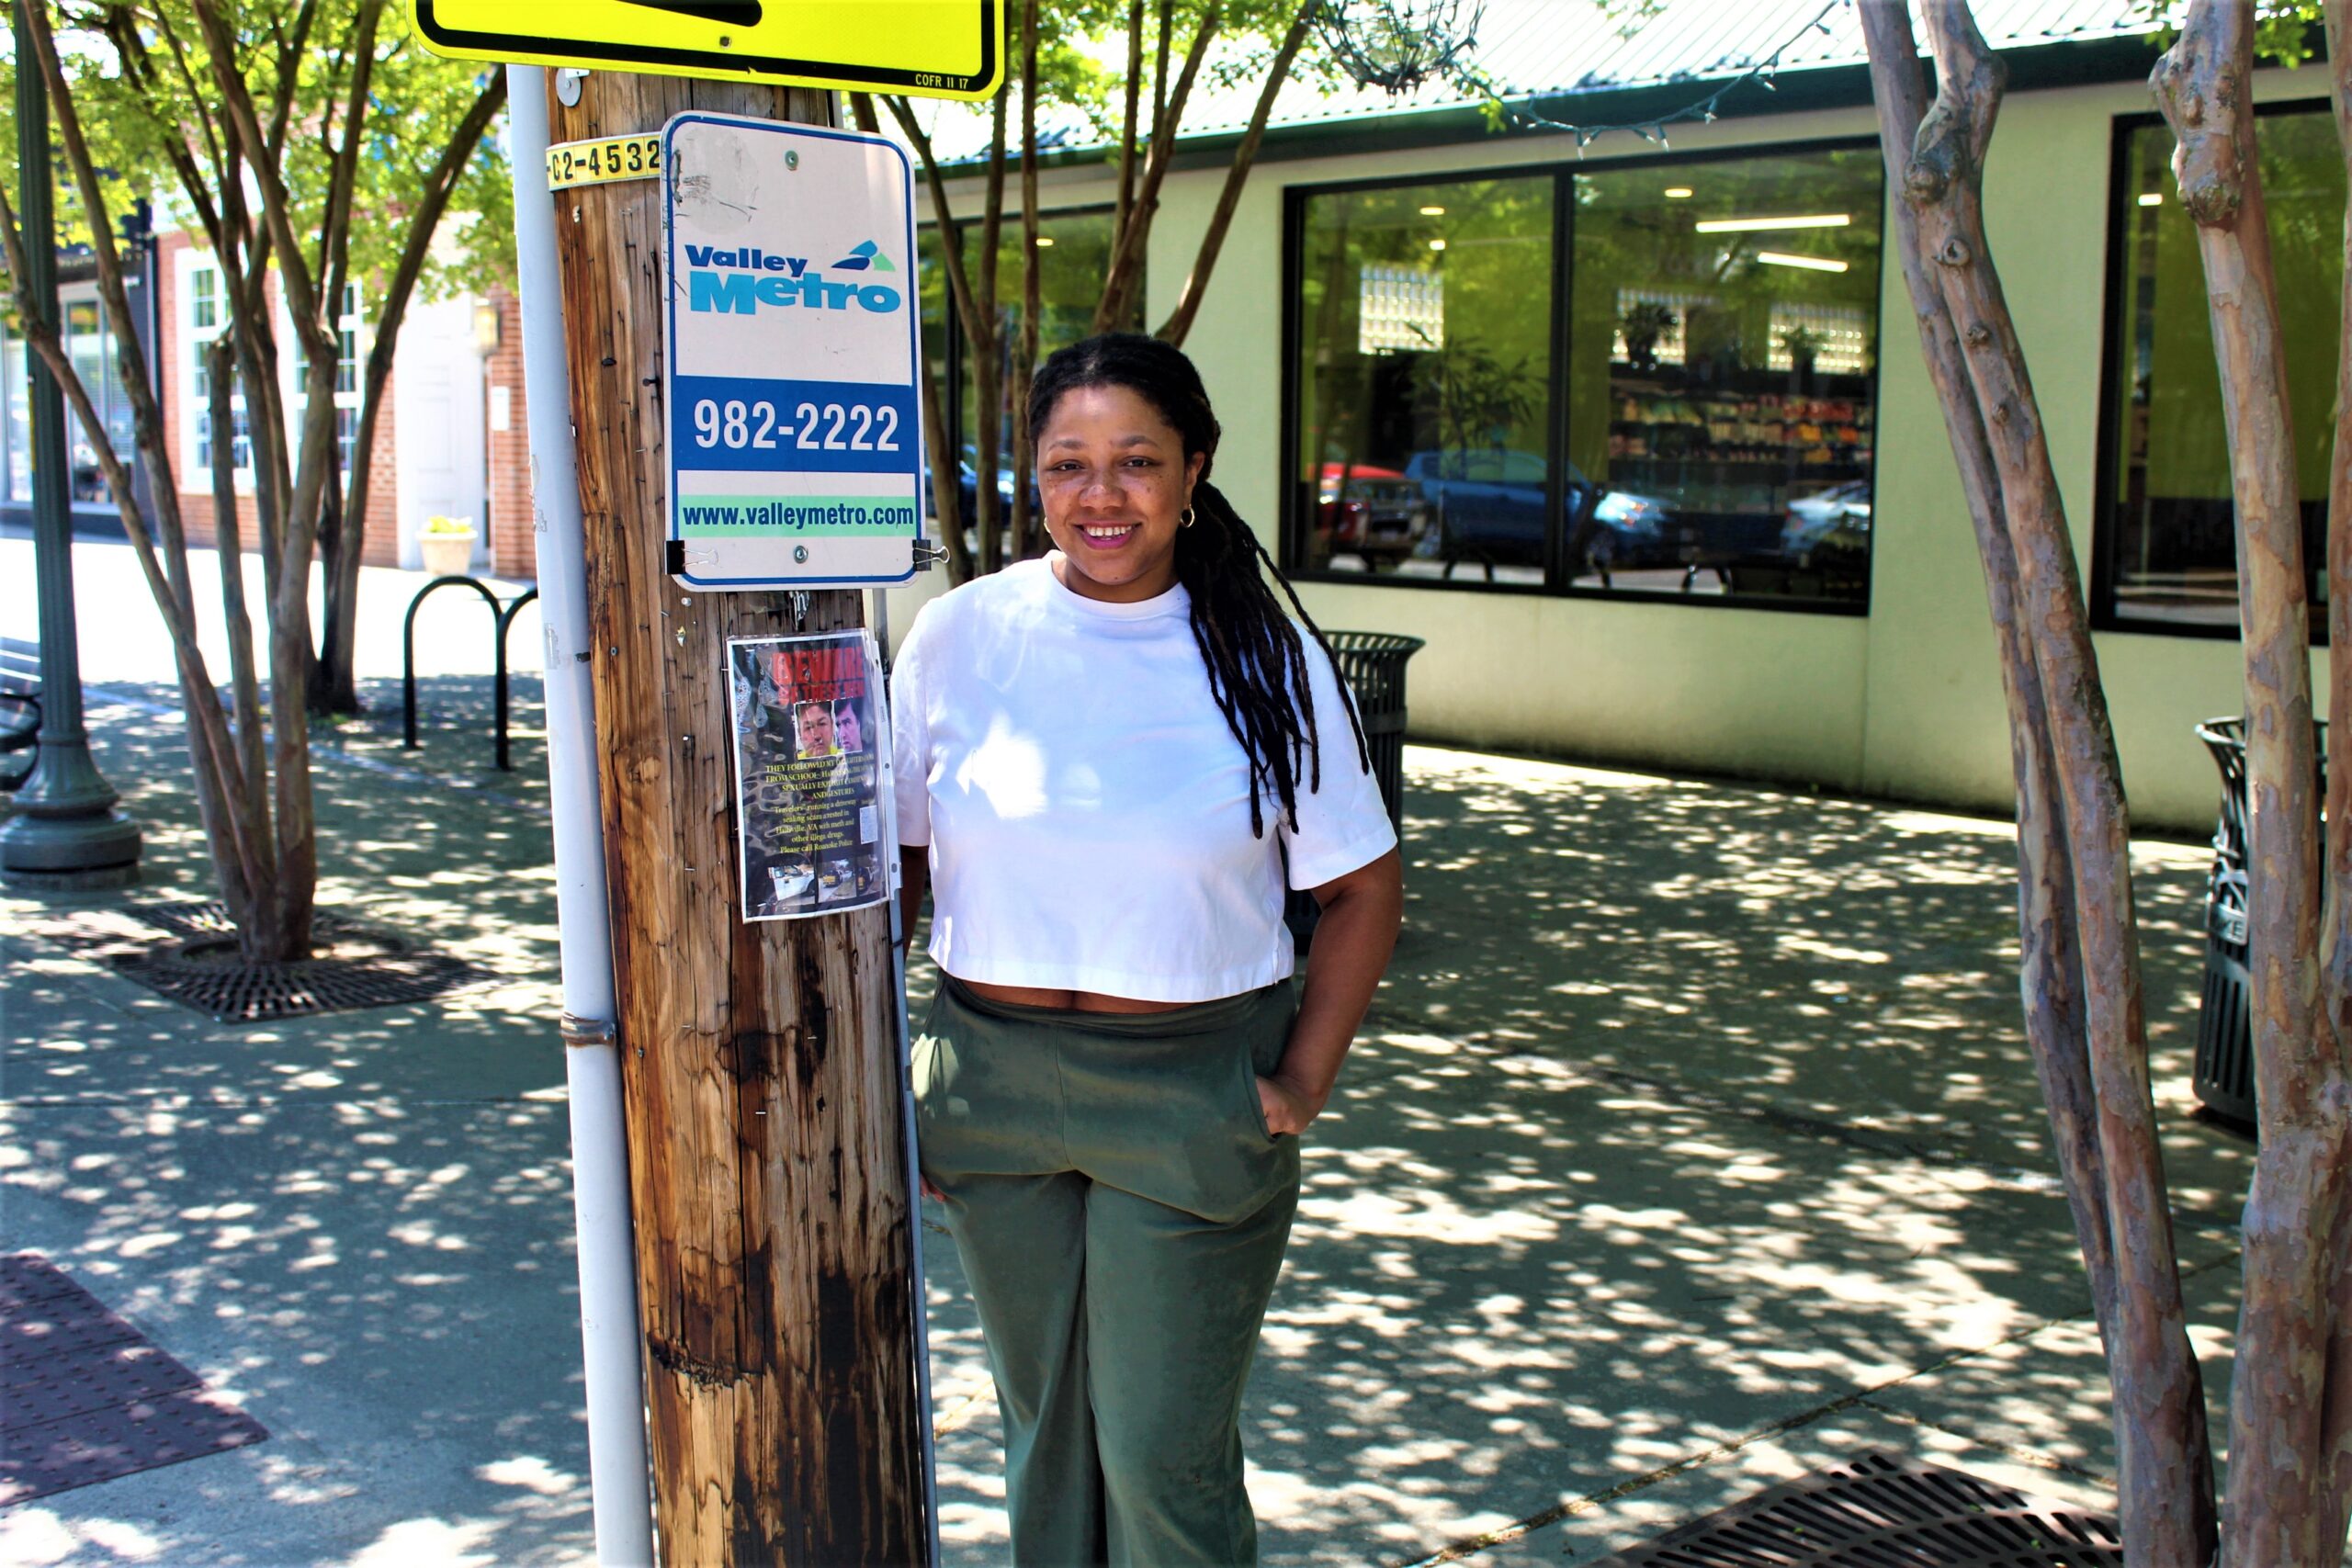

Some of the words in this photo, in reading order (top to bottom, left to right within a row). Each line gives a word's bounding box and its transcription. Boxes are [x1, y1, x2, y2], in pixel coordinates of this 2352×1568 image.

[915, 73, 942, 87] COFR
[959, 78, 968, 89] 17
[684, 244, 808, 277] Valley
[689, 271, 901, 315] Metro
[694, 399, 899, 452] 982-2222
[683, 502, 914, 530] www.valleymetro.com
[772, 646, 865, 686] BEWARE
[765, 763, 786, 773] THEY
[787, 761, 826, 772] FOLLOWED
[765, 774, 787, 784] FROM
[782, 781, 816, 791] SEXUALLY
[813, 791, 827, 799] AND
[808, 823, 818, 831] VA
[791, 834, 808, 843] other
